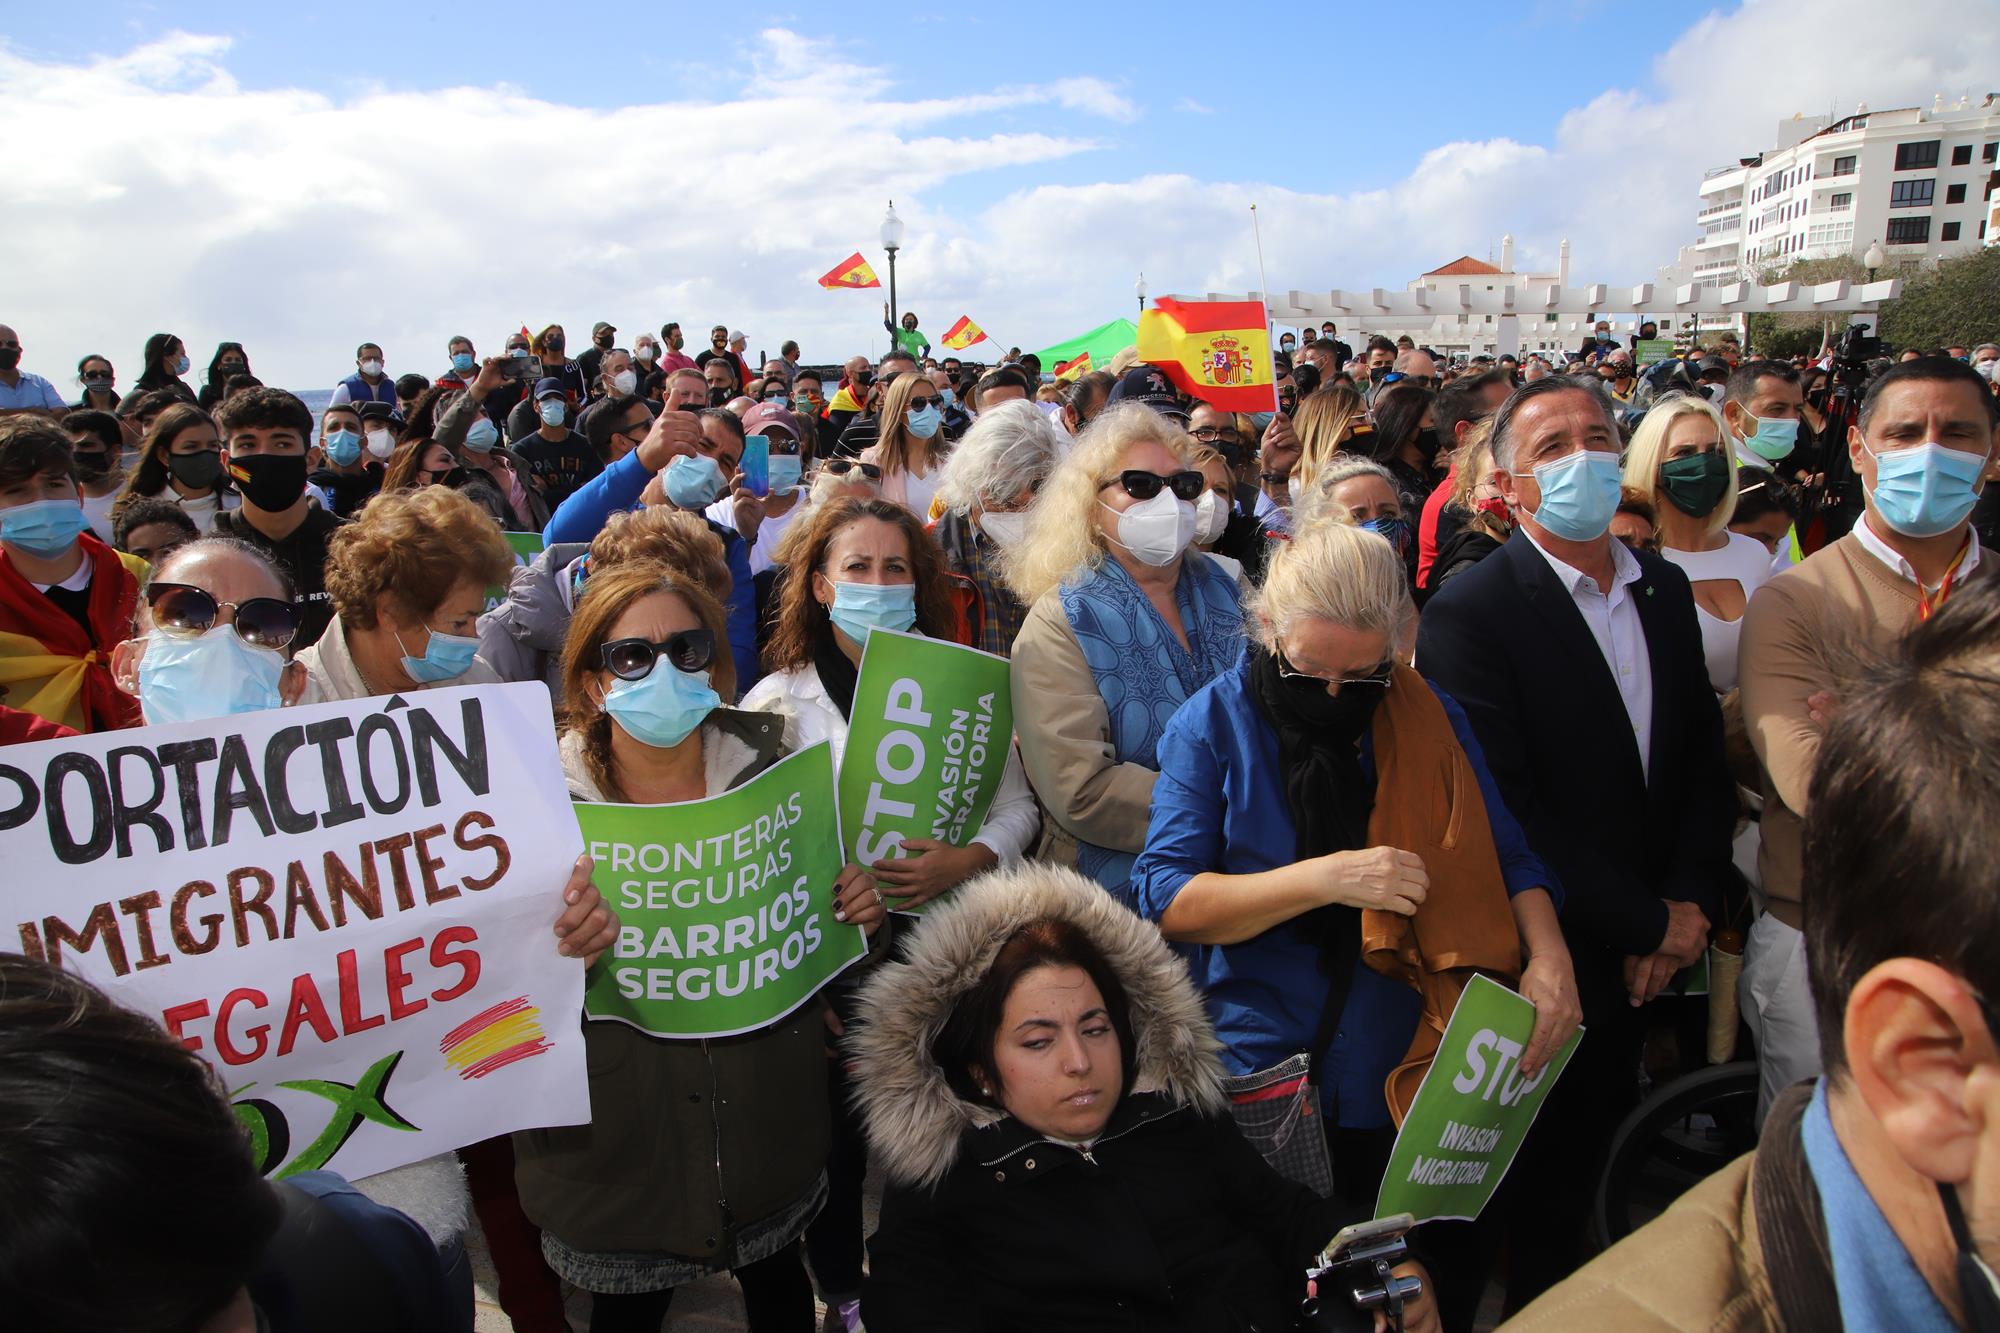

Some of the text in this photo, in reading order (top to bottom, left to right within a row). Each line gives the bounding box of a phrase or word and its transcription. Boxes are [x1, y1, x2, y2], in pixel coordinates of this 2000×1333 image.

[856, 677, 932, 867] STOP
[590, 792, 802, 873] FRONTERAS
[620, 839, 792, 910] SEGURAS
[613, 875, 811, 960] BARRIOS
[615, 913, 822, 1001] SEGUROS
[1406, 1154, 1490, 1185] MIGRATORIA
[1437, 1119, 1504, 1153] INVASIÓN
